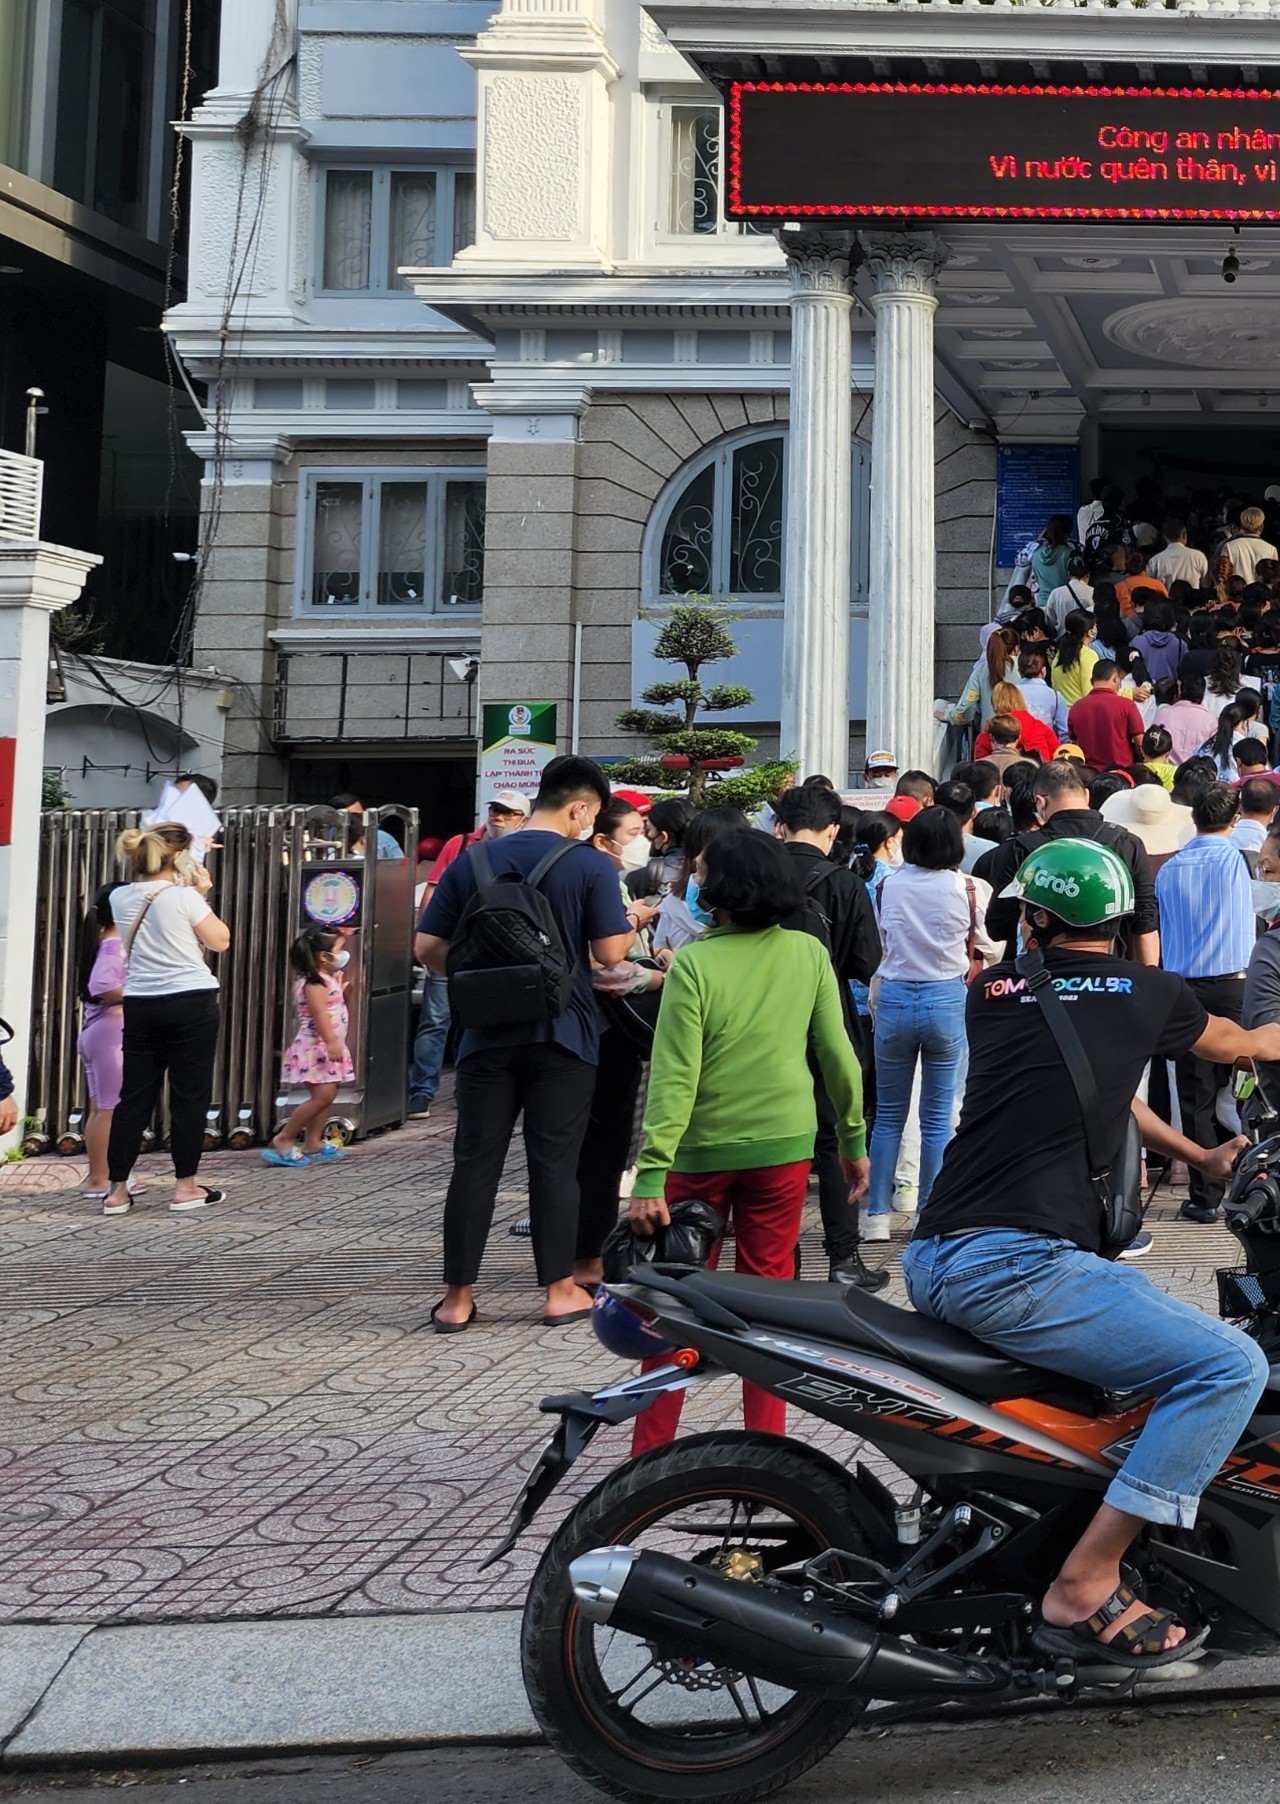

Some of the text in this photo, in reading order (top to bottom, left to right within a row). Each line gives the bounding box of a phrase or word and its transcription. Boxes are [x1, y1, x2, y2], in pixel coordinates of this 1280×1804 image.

[1098, 126, 1168, 153] Công
[1175, 130, 1209, 149] an
[989, 155, 1017, 178] Vì
[1025, 155, 1092, 179] nước
[1100, 157, 1168, 184] quên
[1254, 159, 1277, 182] vì
[1034, 869, 1080, 898] Grab
